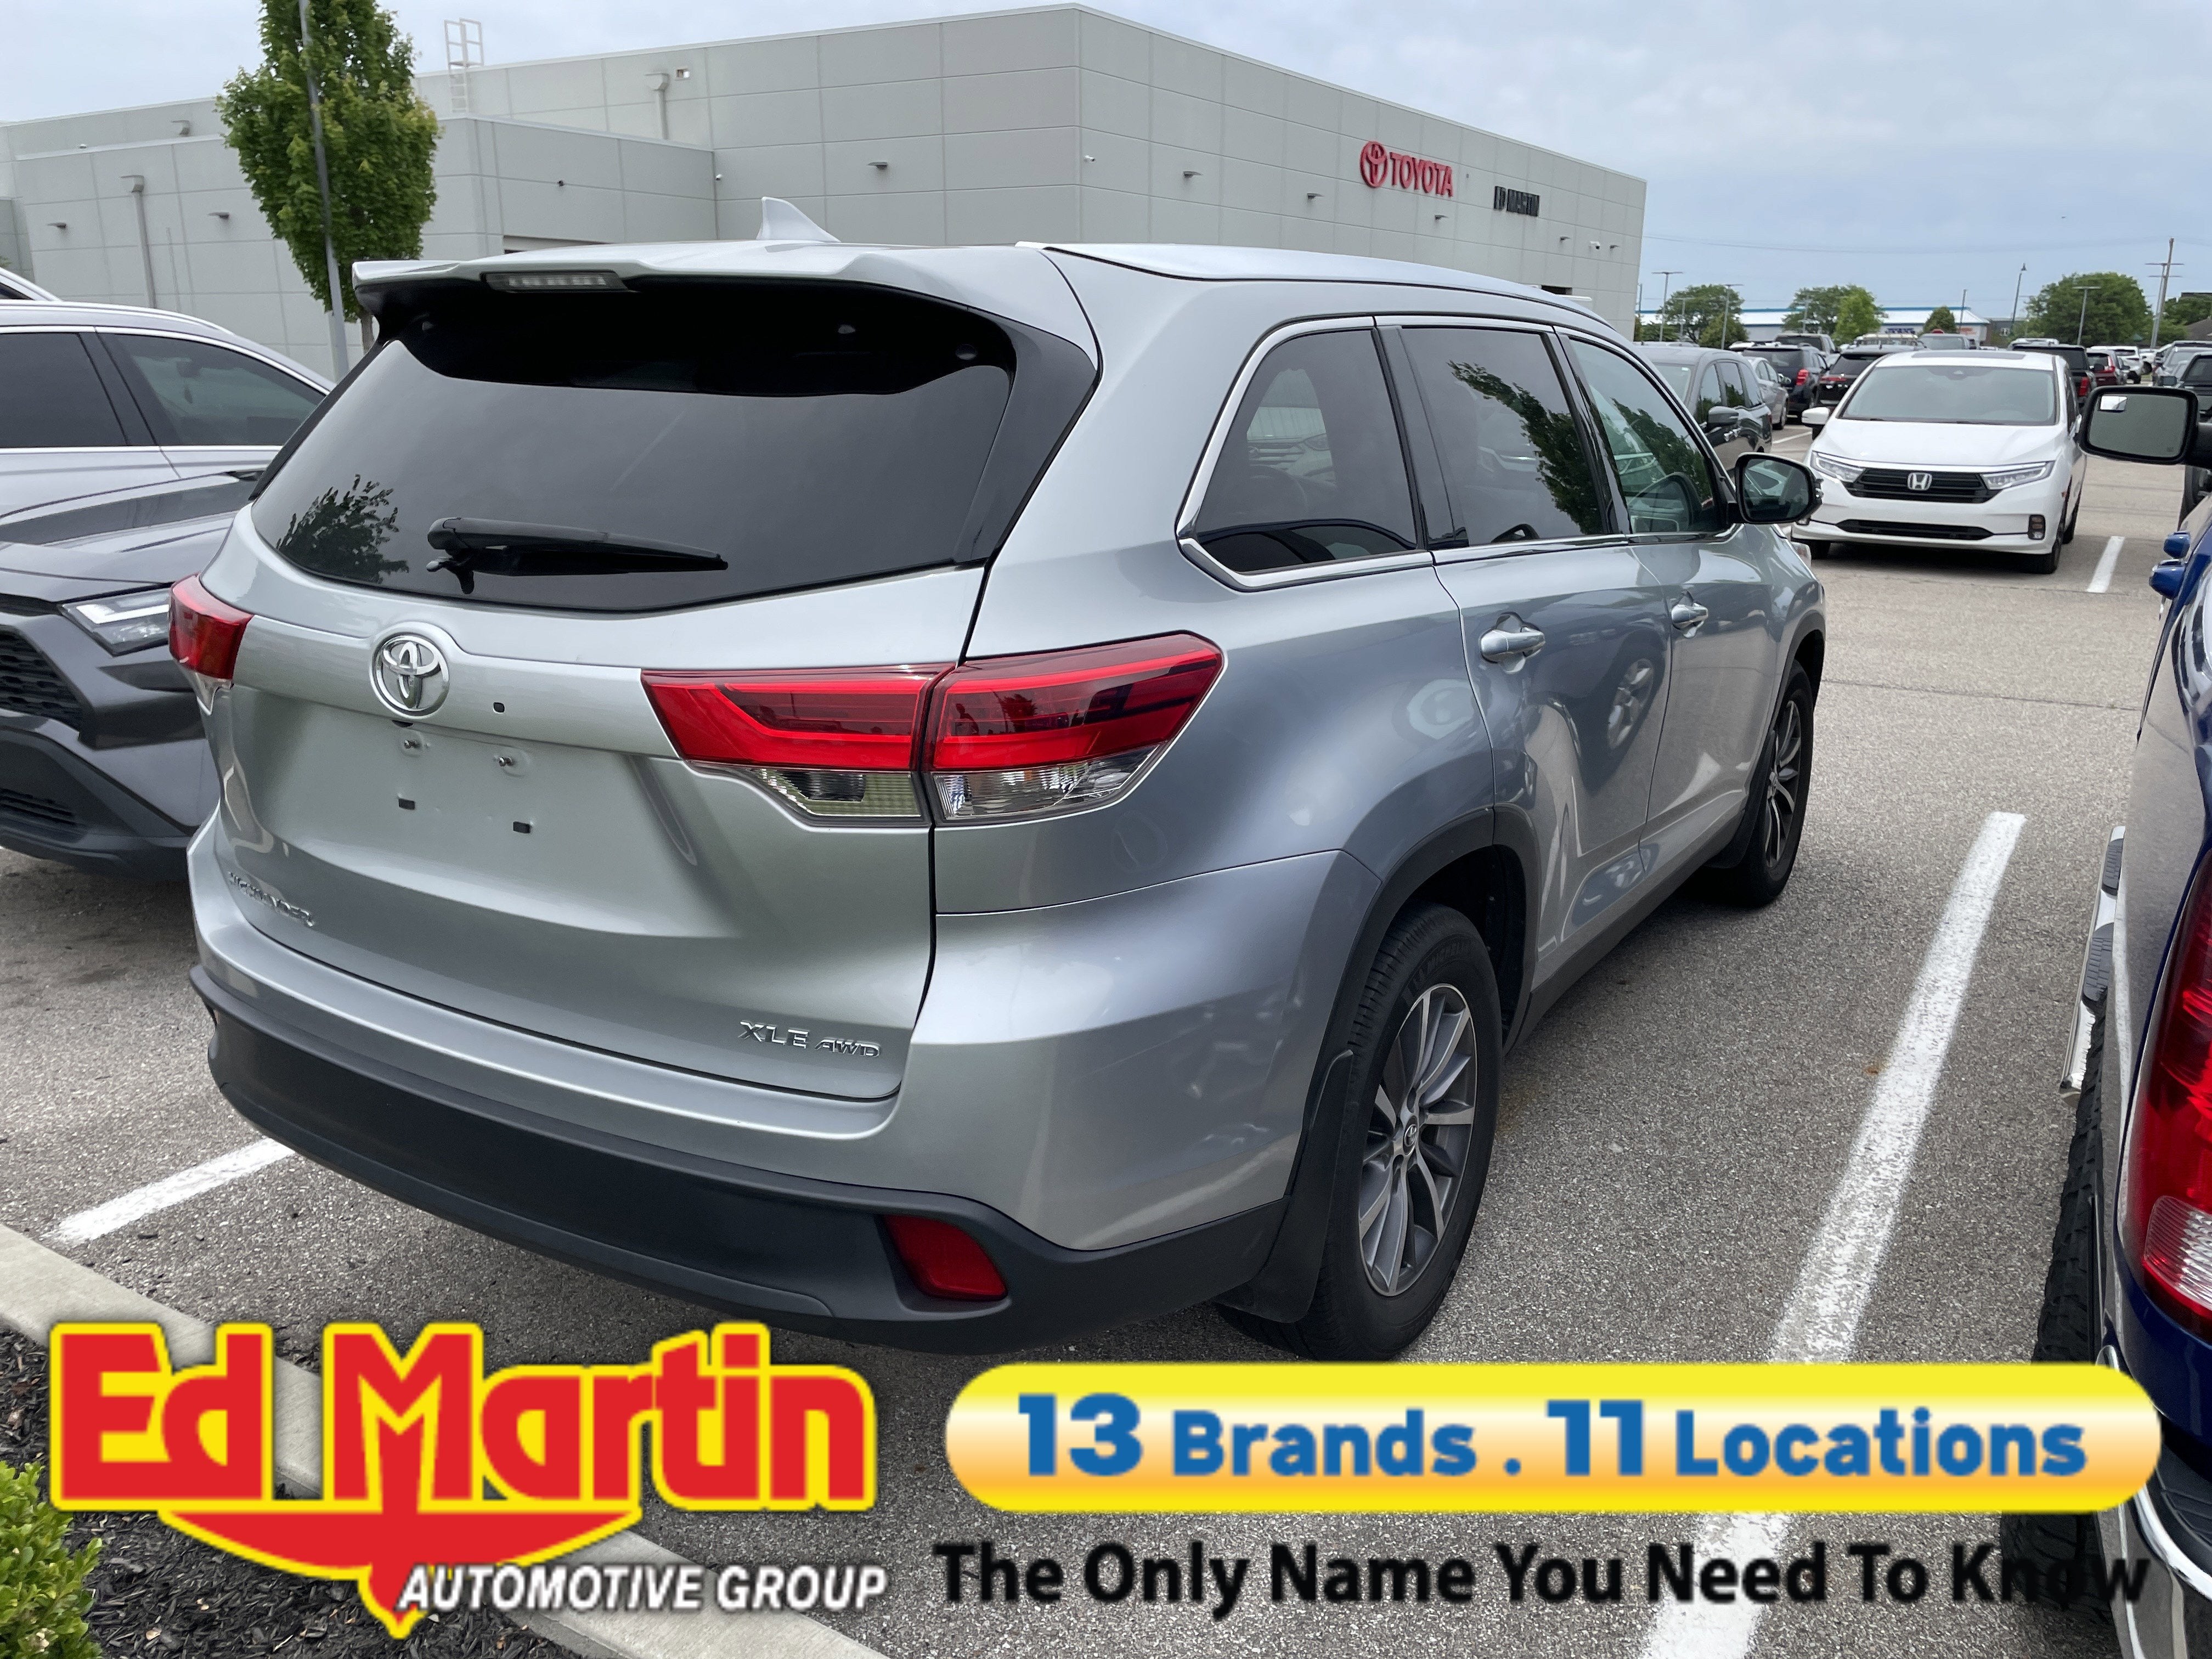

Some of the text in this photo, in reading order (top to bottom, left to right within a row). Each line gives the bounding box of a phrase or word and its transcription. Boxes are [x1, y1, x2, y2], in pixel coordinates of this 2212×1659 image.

[1390, 151, 1454, 198] TOYOTA
[737, 1020, 882, 1058] XLE AWD
